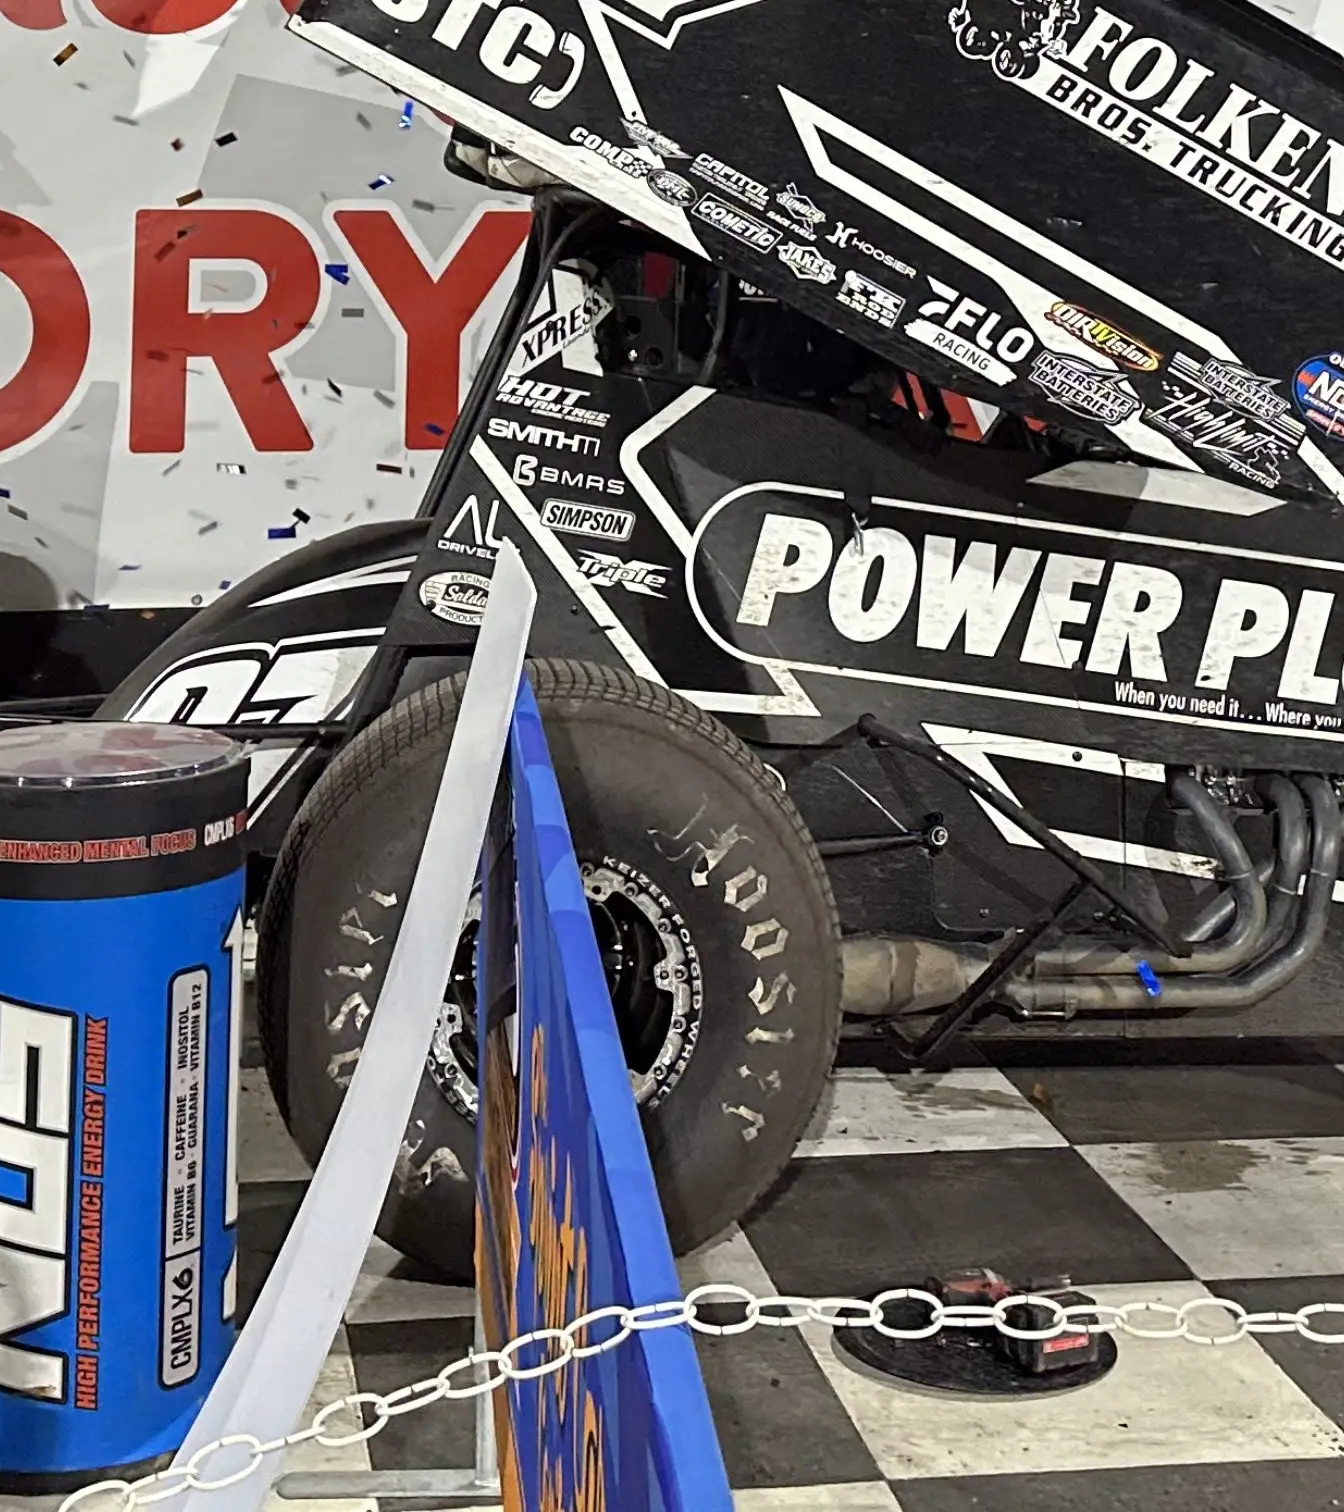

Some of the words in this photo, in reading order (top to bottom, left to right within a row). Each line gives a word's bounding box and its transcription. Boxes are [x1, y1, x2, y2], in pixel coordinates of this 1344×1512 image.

[1046, 73, 1156, 153] BROS.
[569, 126, 635, 165] COMP
[695, 153, 770, 201] CAPITOL
[778, 241, 836, 285] JAKES
[852, 235, 917, 280] HOOSIER
[932, 332, 992, 372] RACING
[944, 296, 1035, 363] FLO
[498, 377, 591, 408] HOT
[1036, 370, 1119, 421] BATTERIES
[1039, 355, 1131, 412] INTERSTATE
[1203, 374, 1274, 420] BATTERIES
[1206, 361, 1284, 412] INTERSTATE
[540, 466, 625, 495] BMRS
[1228, 462, 1278, 489] RACING
[546, 504, 628, 536] SIMPSON
[437, 539, 497, 560] DRIVEL
[576, 555, 667, 588] Triple
[451, 572, 490, 589] RACING
[735, 512, 1184, 683] POWER
[438, 607, 483, 625] PRODUCT
[1114, 681, 1155, 706] When
[1159, 694, 1187, 711] you
[1189, 694, 1225, 717] need
[1265, 702, 1312, 726] Where
[83, 836, 149, 863] MENTAL
[603, 856, 671, 910] KEIZER
[671, 913, 703, 1010] FORGED
[191, 983, 202, 1011] B12
[84, 1014, 109, 1086] DRINK
[177, 1006, 190, 1069] INOSITOL
[189, 1014, 201, 1072] VITAMIN
[80, 1086, 106, 1179] ENERGY
[175, 1094, 188, 1161] CAFFEINE
[187, 1081, 199, 1149] GUARANA
[173, 1185, 185, 1246] TAURINE
[185, 1183, 197, 1242] VITAMIN
[76, 1179, 104, 1352] PERFORMANCE
[170, 1267, 194, 1369] CMPLX6
[74, 1354, 99, 1411] HIGH
